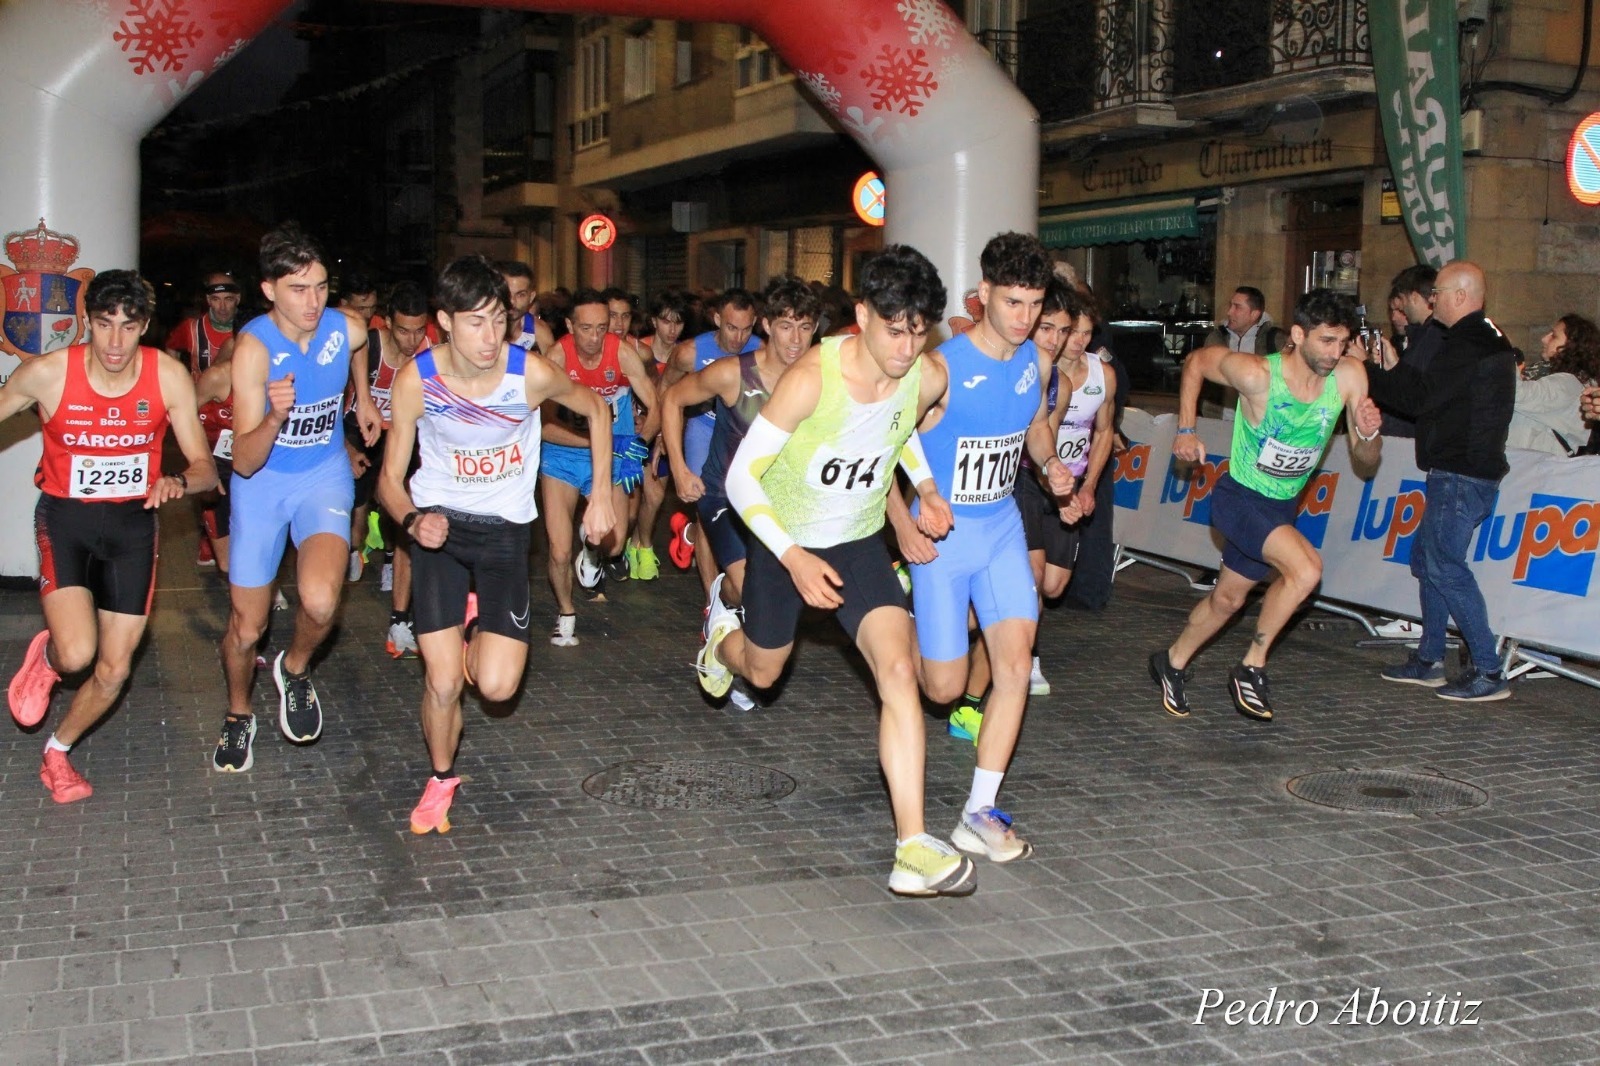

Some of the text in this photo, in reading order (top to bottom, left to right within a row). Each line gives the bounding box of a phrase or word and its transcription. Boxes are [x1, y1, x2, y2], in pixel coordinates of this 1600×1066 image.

[1081, 155, 1163, 193] Cupido
[290, 396, 340, 414] TLETISMO
[100, 417, 127, 427] Beco
[277, 434, 330, 447] ORRELAVEG
[959, 433, 1024, 449] ATLETISMO
[454, 444, 523, 476] 10674
[820, 455, 882, 490] 614
[958, 446, 1020, 491] 11703
[1271, 453, 1311, 470] 522
[77, 468, 143, 485] 12258
[1160, 453, 1231, 518] lup
[953, 485, 1014, 503] TORRELAVEGA
[1351, 480, 1425, 557] lup
[1473, 489, 1600, 581] lupa
